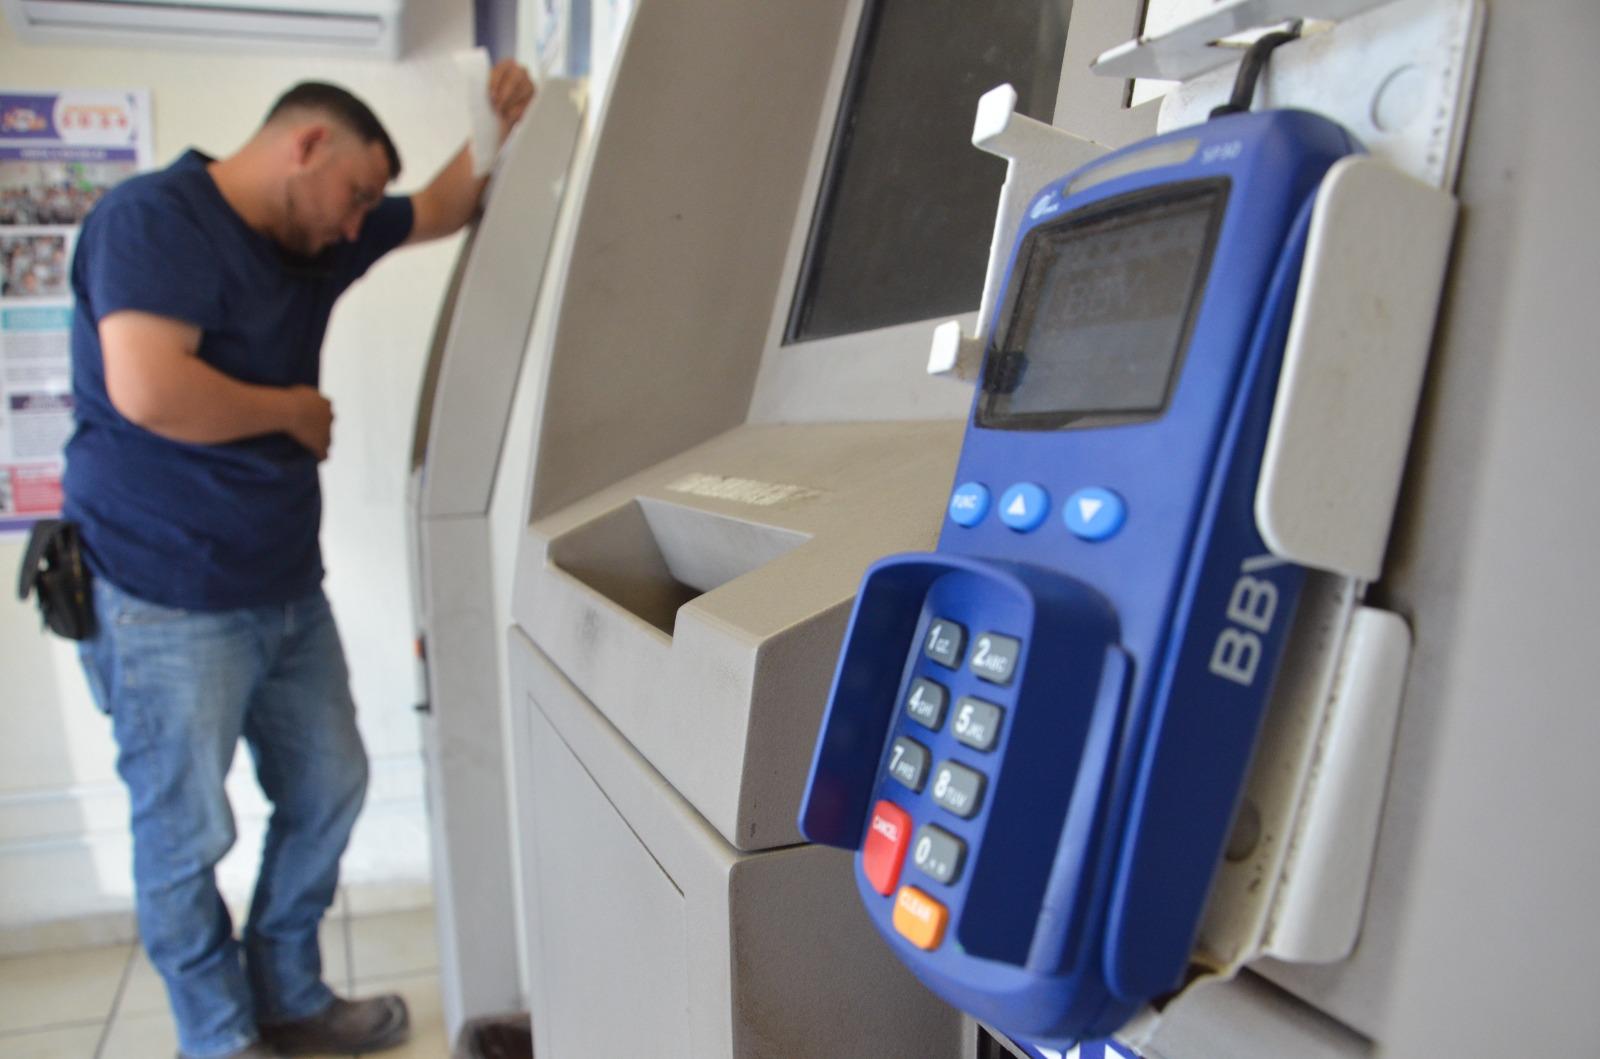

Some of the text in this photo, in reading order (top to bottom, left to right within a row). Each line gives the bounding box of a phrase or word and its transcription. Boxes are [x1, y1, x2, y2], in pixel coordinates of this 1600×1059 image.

[928, 624, 942, 650] 1
[972, 637, 991, 667] 2
[909, 686, 925, 711] 4
[956, 704, 974, 733] 5
[889, 745, 905, 770] 7
[935, 769, 951, 798] 8
[873, 815, 898, 842] CANCEL
[915, 836, 932, 865] 0
[900, 889, 933, 923] CLEAR
